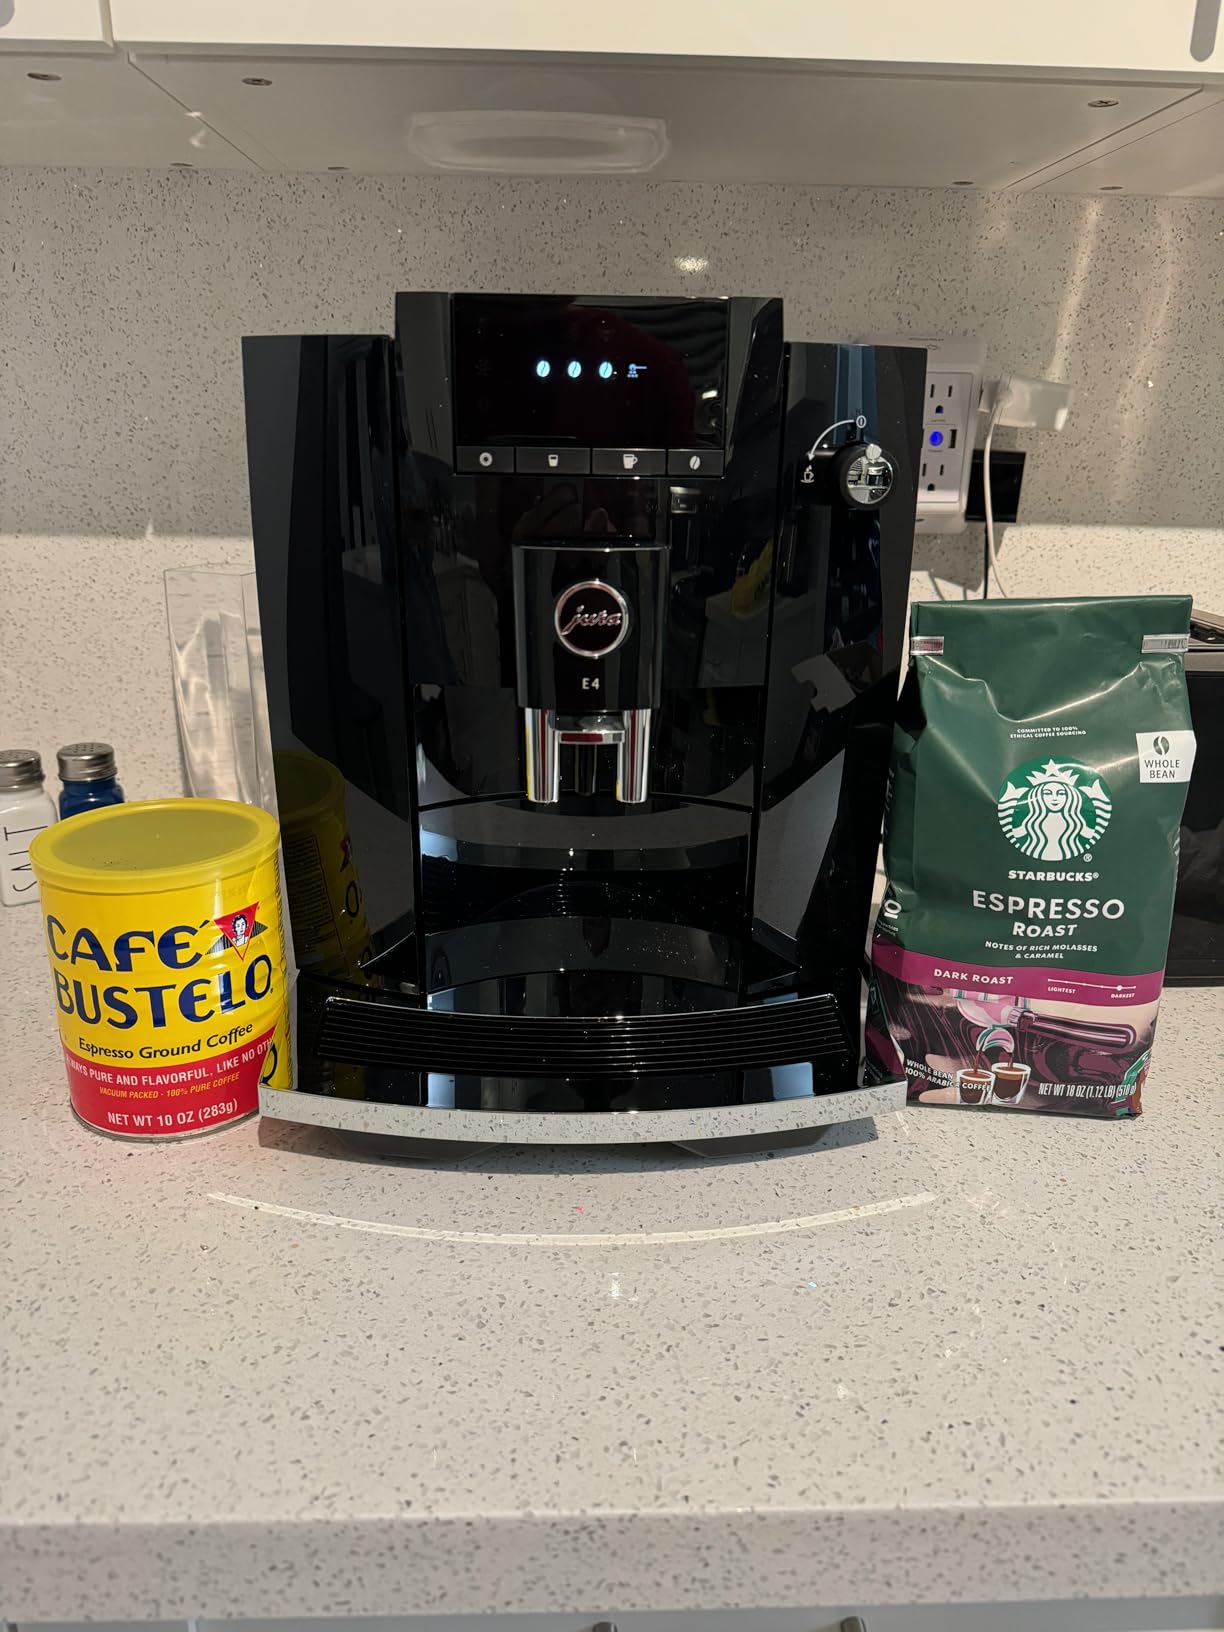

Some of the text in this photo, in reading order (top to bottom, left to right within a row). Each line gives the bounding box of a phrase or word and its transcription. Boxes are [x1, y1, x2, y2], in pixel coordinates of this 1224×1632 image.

[581, 677, 600, 690] E4
[1144, 759, 1180, 768] WHOLE
[1149, 770, 1176, 779] BEAN
[972, 889, 1125, 919] ESPRESSO
[1012, 921, 1077, 937] ROAST
[985, 940, 1014, 951] NOTES
[1052, 944, 1098, 953] MOLASSES
[933, 968, 1014, 985] DARK ROAST
[54, 954, 272, 1030] BUSTELO
[1048, 986, 1076, 994] LIGHTEST
[79, 1023, 253, 1059] Espresso Ground Coffee
[89, 1068, 114, 1084] PURE
[116, 1074, 138, 1086] AND
[216, 1056, 240, 1073] LIKE
[241, 1048, 255, 1063] NO
[906, 1058, 954, 1080] WHOLE BEAN
[99, 1086, 128, 1098] VACUUM
[129, 1090, 159, 1099] PACKED
[166, 1087, 188, 1098] 100%
[189, 1082, 211, 1094] PURE
[212, 1071, 240, 1088] COFFEE
[905, 1066, 926, 1079] 100%
[926, 1075, 960, 1089] ARABICA
[1038, 1082, 1053, 1096] NET
[1053, 1083, 1066, 1097] WT
[1066, 1084, 1075, 1097] 18
[1075, 1085, 1087, 1098] OZ
[1086, 1085, 1103, 1099] (1.12
[1104, 1085, 1116, 1099] LB)
[107, 1097, 238, 1127] NET WT 10 OZ (283g)
